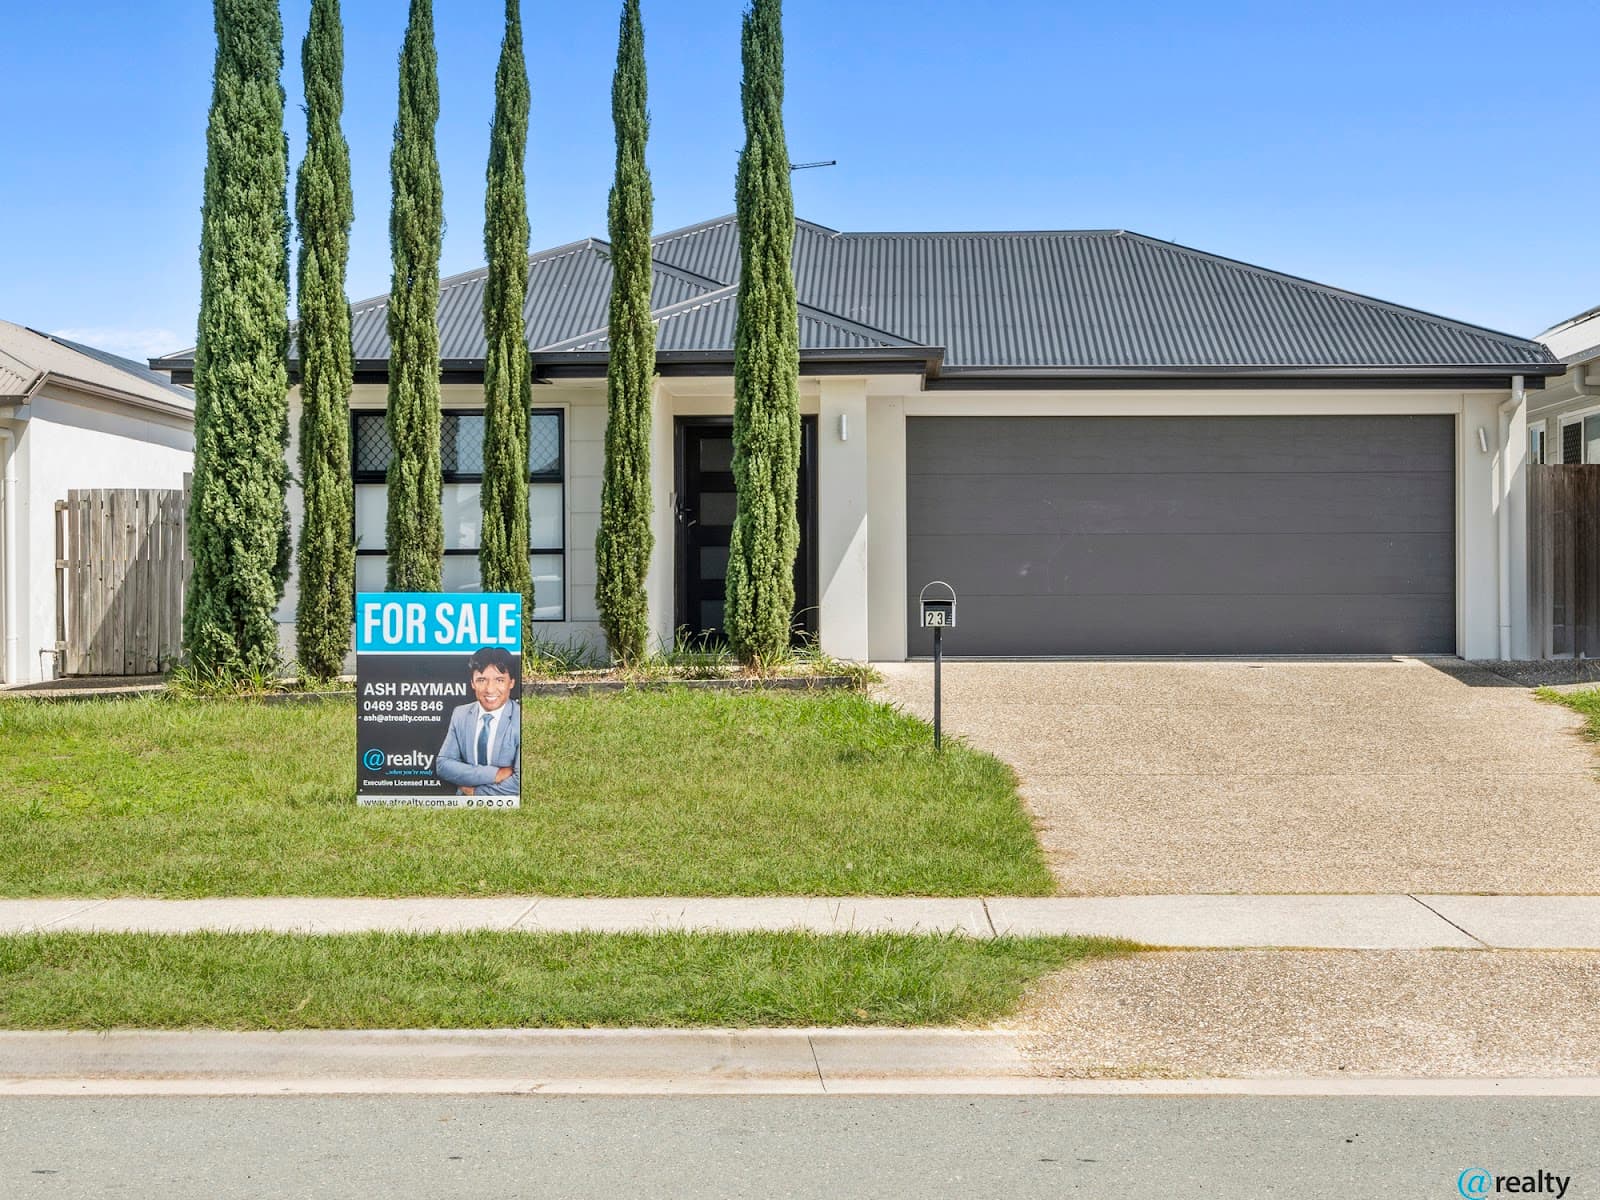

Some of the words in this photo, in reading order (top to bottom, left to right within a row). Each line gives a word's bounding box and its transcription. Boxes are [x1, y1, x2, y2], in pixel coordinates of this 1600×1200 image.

[363, 602, 427, 644] FOR
[434, 602, 517, 644] SALE
[927, 612, 944, 625] 23
[363, 683, 396, 696] ASH
[400, 683, 466, 696] PAYMAN
[363, 700, 393, 712] 0469
[396, 700, 418, 712] 385
[420, 700, 444, 712] 846
[363, 714, 441, 723] ash@atrealty.com.au
[363, 748, 434, 770] @realty
